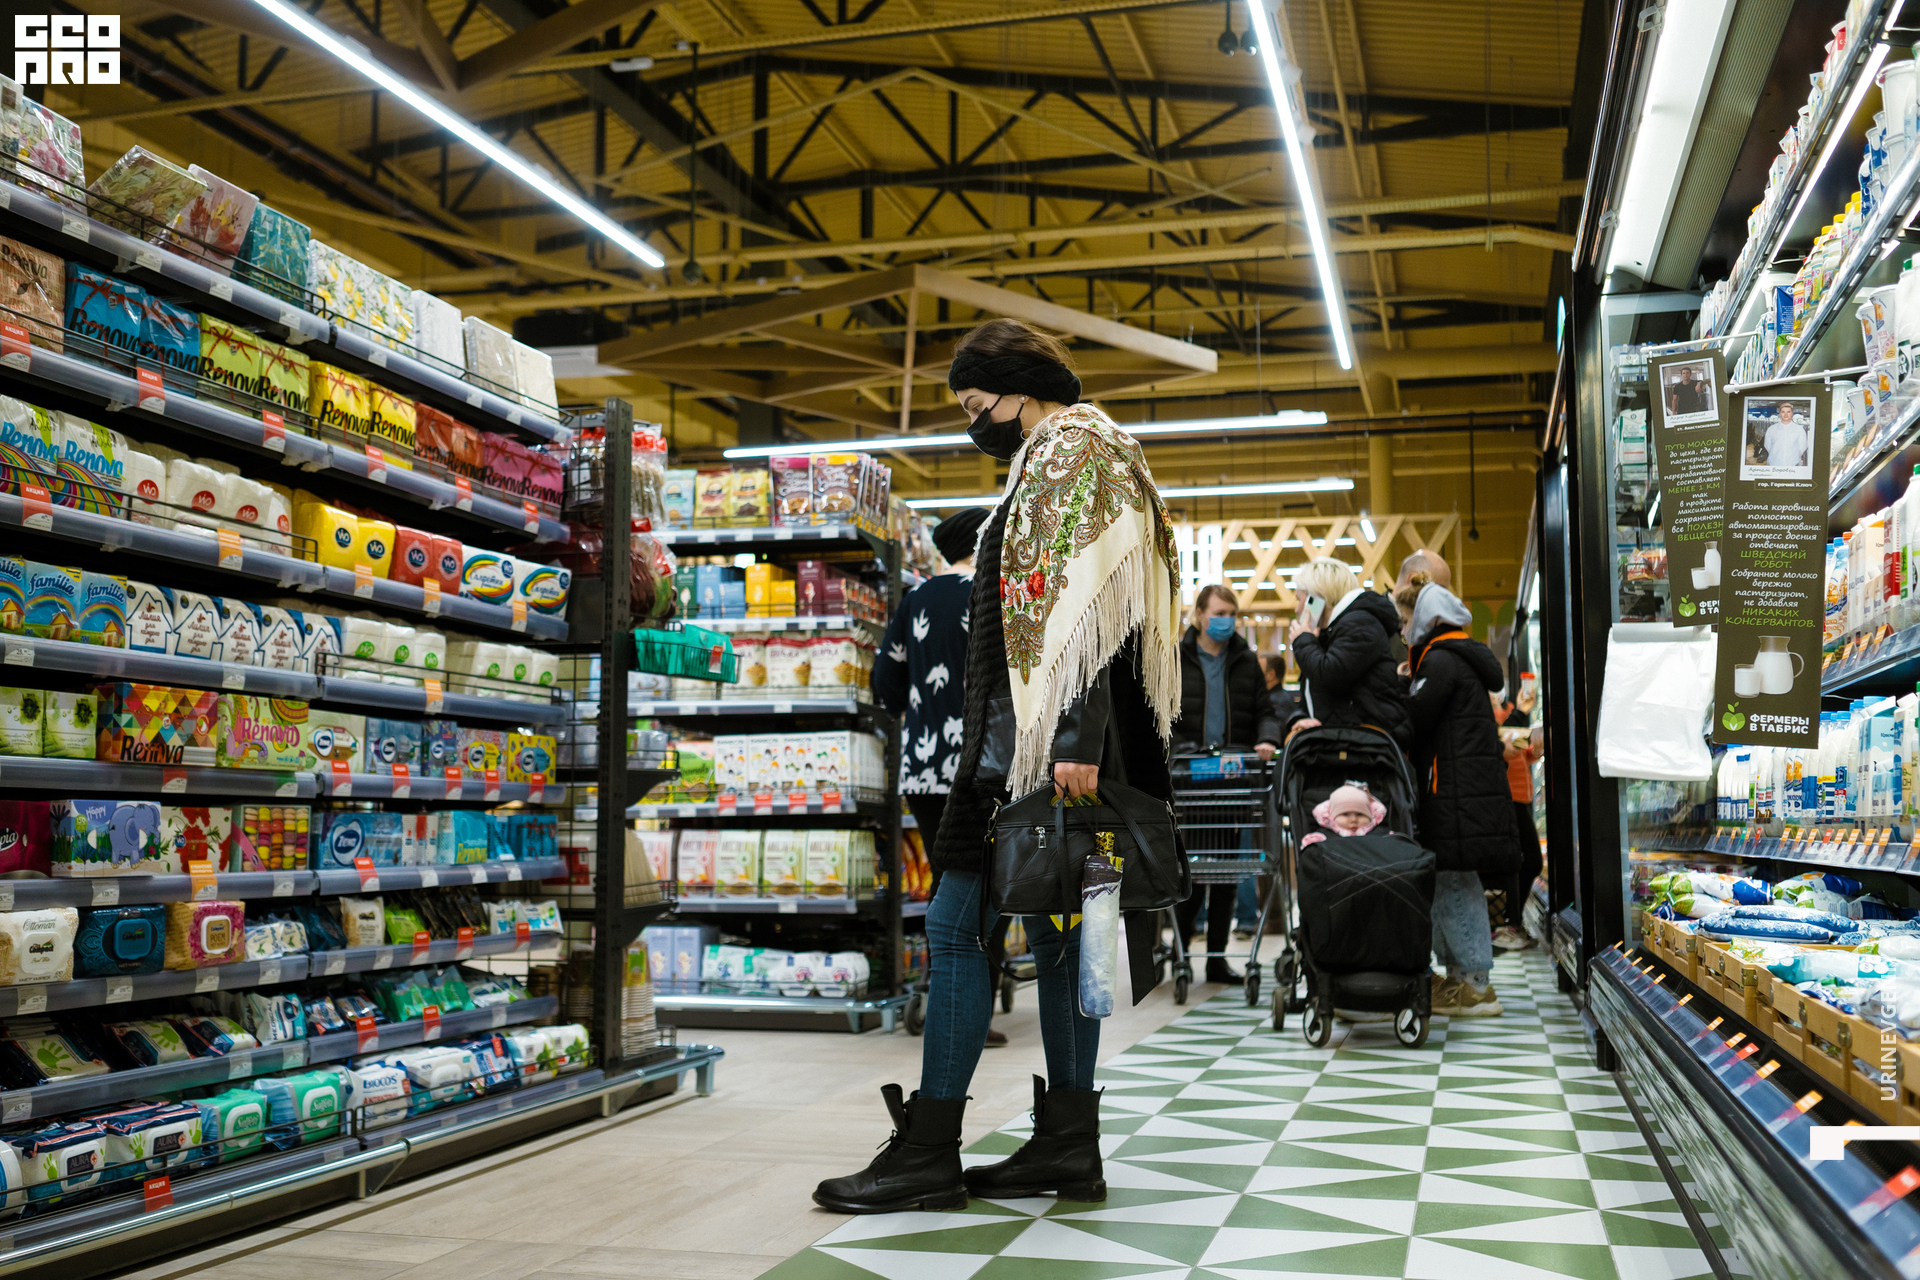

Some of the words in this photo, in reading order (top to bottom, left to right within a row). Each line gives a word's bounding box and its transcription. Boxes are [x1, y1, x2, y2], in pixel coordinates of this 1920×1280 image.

[5, 325, 24, 336] АКЦИЯ
[320, 400, 369, 436] Renova
[371, 411, 416, 447] Renova
[1, 421, 60, 463] Renova
[1665, 443, 1685, 451] ПУТЬ
[1688, 438, 1726, 448] МОЛОКА
[65, 440, 123, 477] Renova
[1670, 454, 1723, 465] пастеризуют
[1689, 462, 1713, 470] затем
[1676, 476, 1721, 486] составляет
[26, 486, 44, 496] АКЦИЯ
[1668, 485, 1696, 494] МЕНЕЕ
[1706, 482, 1720, 490] КМ
[1686, 497, 1721, 508] продукте
[1732, 502, 1768, 511] Работа
[1771, 502, 1820, 513] коровника
[1672, 525, 1684, 533] все
[1728, 520, 1822, 532] автоматизирована:
[1745, 533, 1782, 541] процесс
[1785, 531, 1817, 540] доения
[1749, 541, 1798, 549] отвечает
[1740, 550, 1807, 560] ШВЕДСКИЙ
[1754, 560, 1792, 568] РОБОТ.
[1731, 568, 1780, 579] Собранное
[28, 573, 75, 596] familia
[1752, 578, 1792, 589] бережно
[85, 583, 125, 604] familia
[1735, 590, 1808, 599] пастеризуют,
[1757, 598, 1798, 607] добавляя
[1742, 608, 1799, 617] НИКАКИХ
[1725, 617, 1816, 627] КОНСЕРВАНТОВ.
[1750, 714, 1809, 725] ФЕРМЕРЫ
[242, 718, 300, 747] Renova
[1750, 723, 1757, 731] В
[1760, 724, 1809, 734] ТАБРИС
[119, 736, 184, 764] Renova
[23, 918, 56, 931] Ottoman
[156, 1134, 177, 1148] AURA
[70, 1154, 90, 1168] AURA
[148, 1181, 166, 1190] АКЦИЯ
